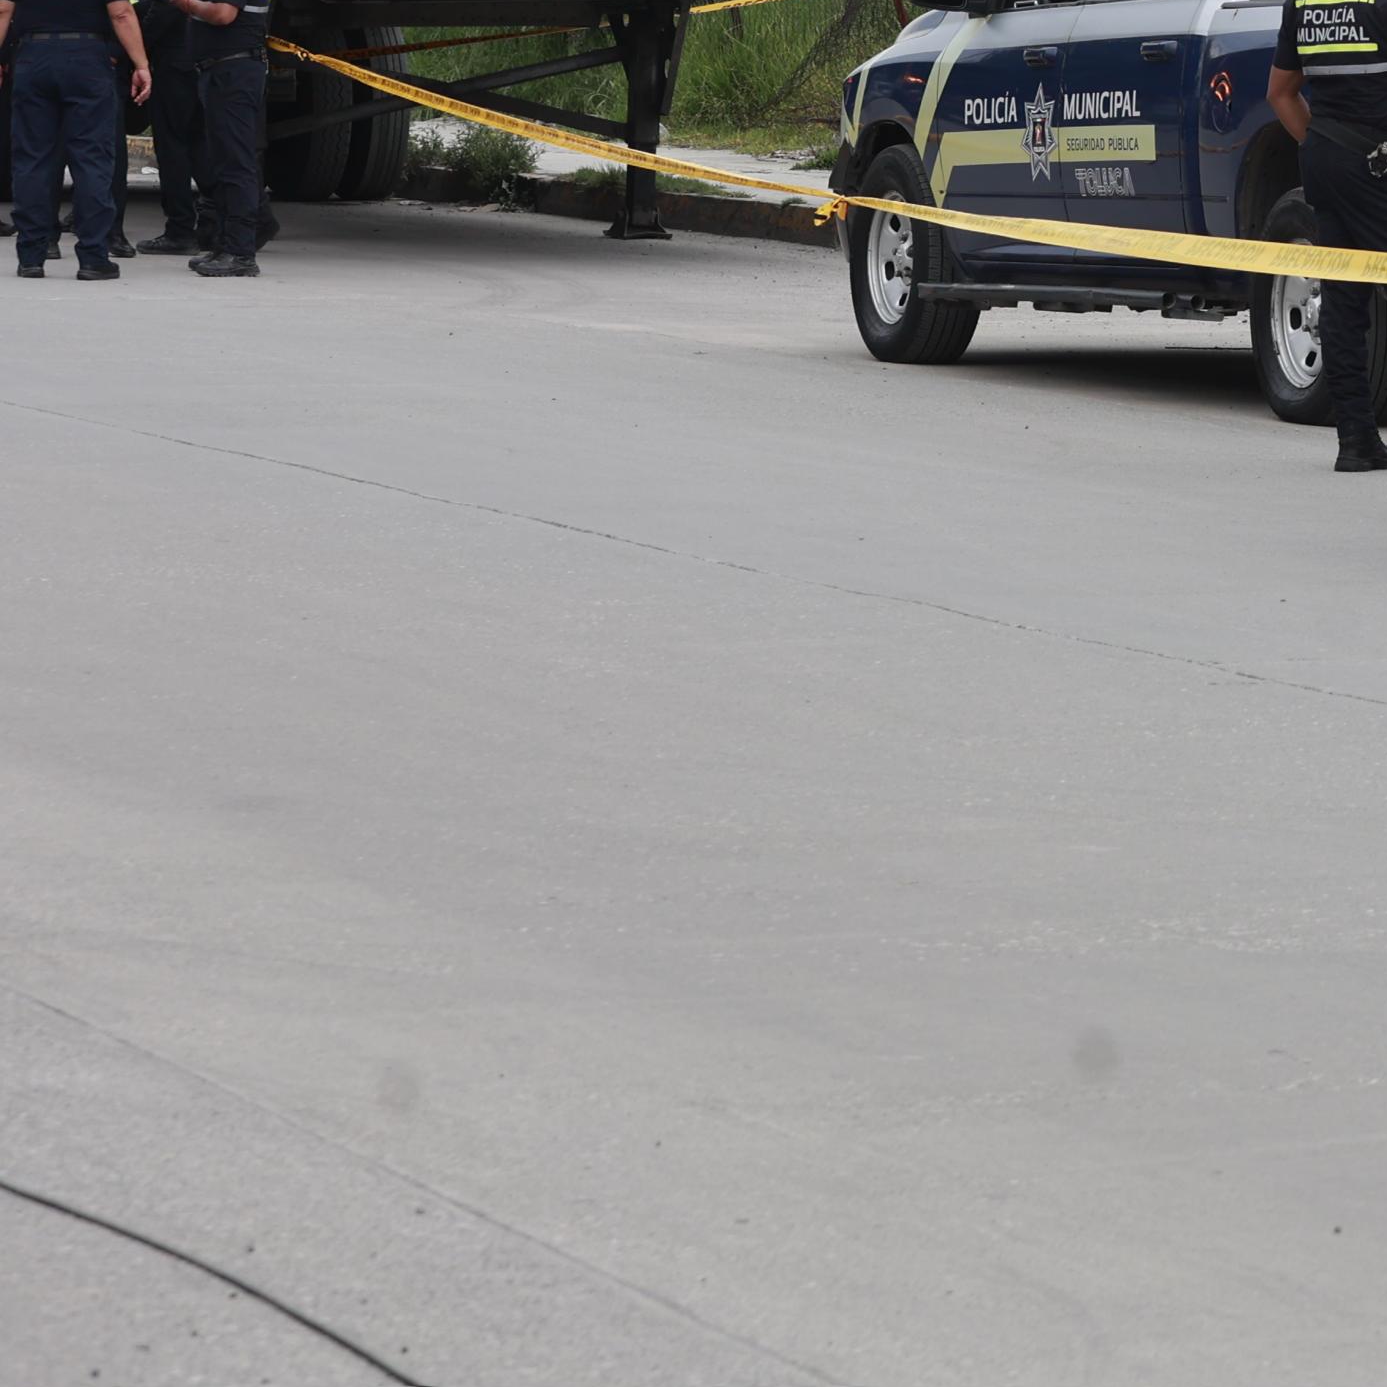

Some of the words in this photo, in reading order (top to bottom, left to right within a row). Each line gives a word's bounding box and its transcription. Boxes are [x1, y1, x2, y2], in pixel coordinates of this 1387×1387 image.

[1303, 6, 1356, 25] POLICÍA
[1297, 25, 1370, 43] MUNICIPAL
[964, 91, 1018, 125] POLICÍA
[1063, 90, 1141, 121] MUNICIPAL
[1066, 137, 1105, 151] SEGURIDAD
[1074, 167, 1136, 197] TOLUCA
